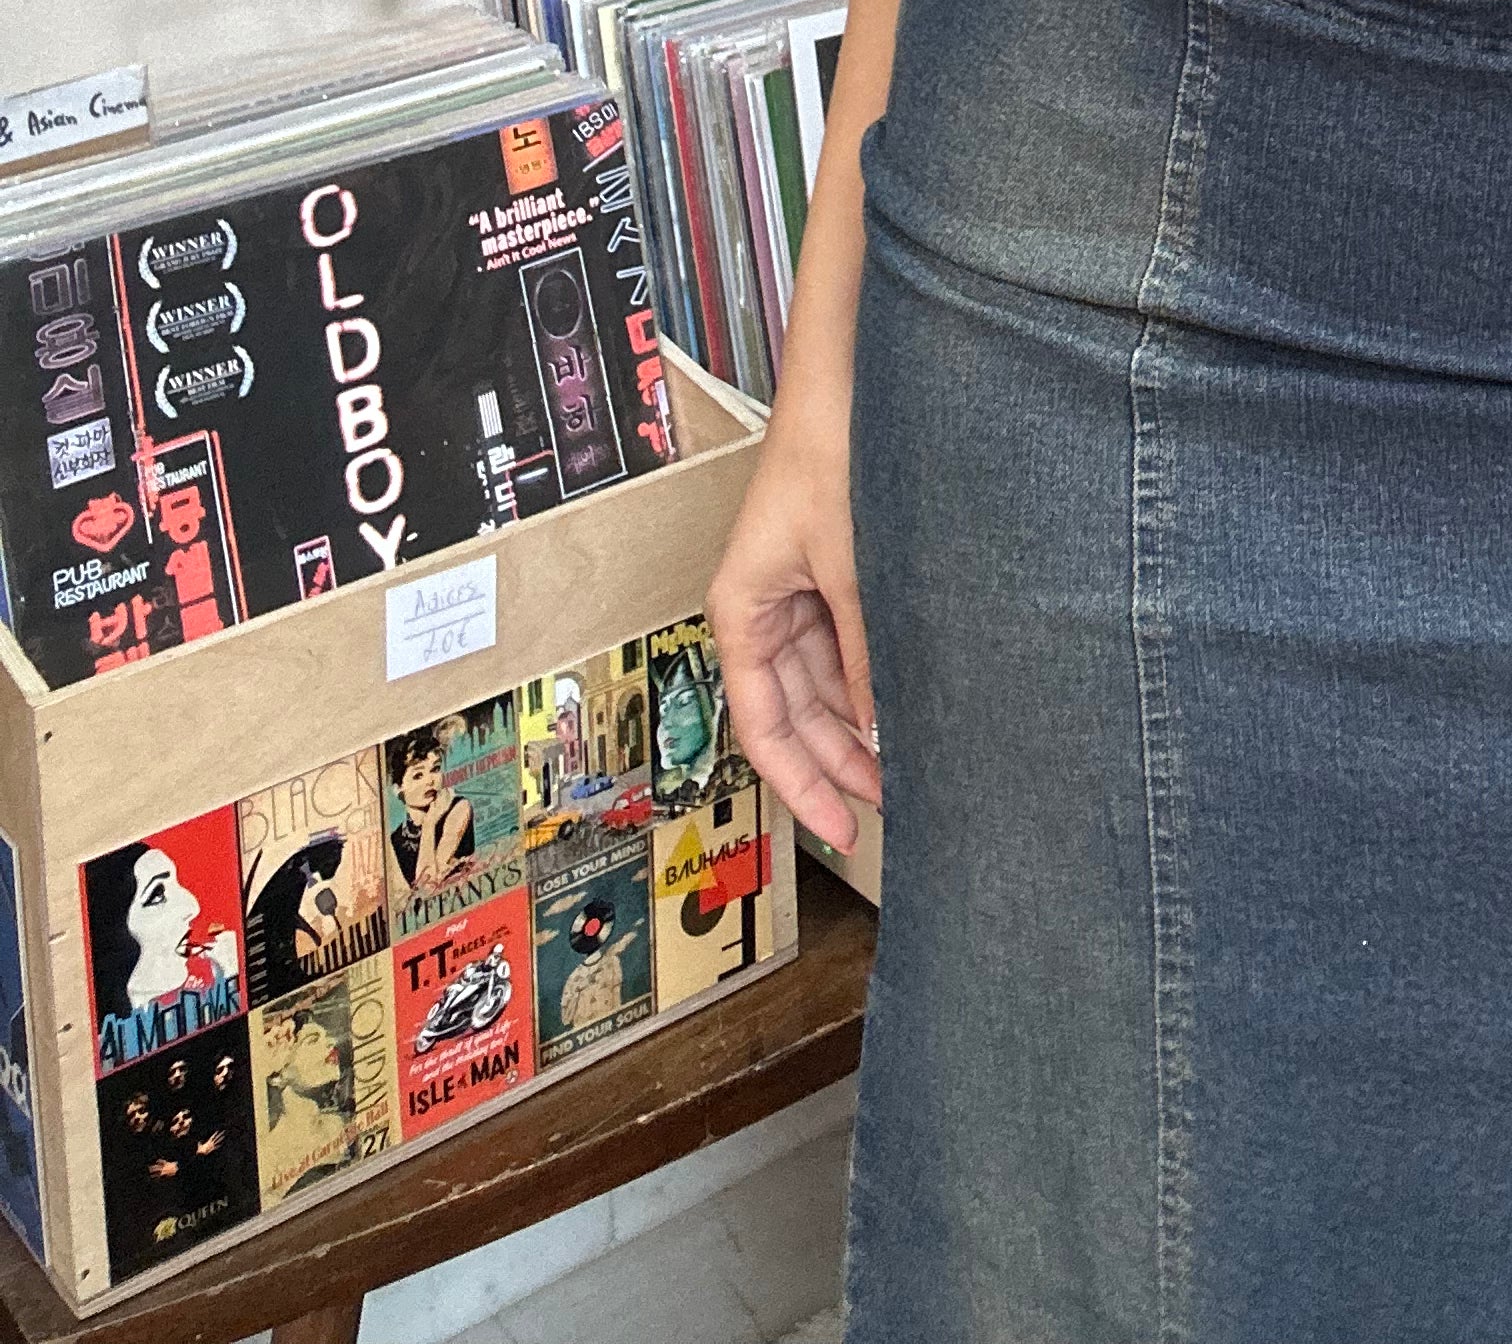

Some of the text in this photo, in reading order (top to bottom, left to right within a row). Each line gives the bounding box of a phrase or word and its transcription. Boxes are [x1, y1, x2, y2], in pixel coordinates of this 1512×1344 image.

[27, 109, 78, 136] Asian
[493, 186, 566, 230] brilliant
[151, 231, 226, 261] WINNER
[521, 239, 548, 260] Cool
[159, 294, 232, 325] WINNER
[168, 358, 243, 390] WINNER
[299, 182, 406, 571] OLDBOY
[52, 558, 102, 591] PUB
[54, 561, 150, 609] RESTAURANT
[239, 752, 379, 854] BLACK
[536, 869, 570, 897] LOSE
[571, 852, 609, 882] YOUR
[610, 837, 646, 865] MIND
[664, 832, 751, 887] BAUHAUS
[349, 977, 388, 1115] HOLIDAY
[576, 1020, 614, 1046] YOUR
[616, 1004, 651, 1027] SOUL
[408, 1075, 456, 1117] ISLE
[470, 1039, 520, 1087] MAN
[363, 1125, 390, 1160] 27
[176, 1194, 229, 1231] QUEEN
